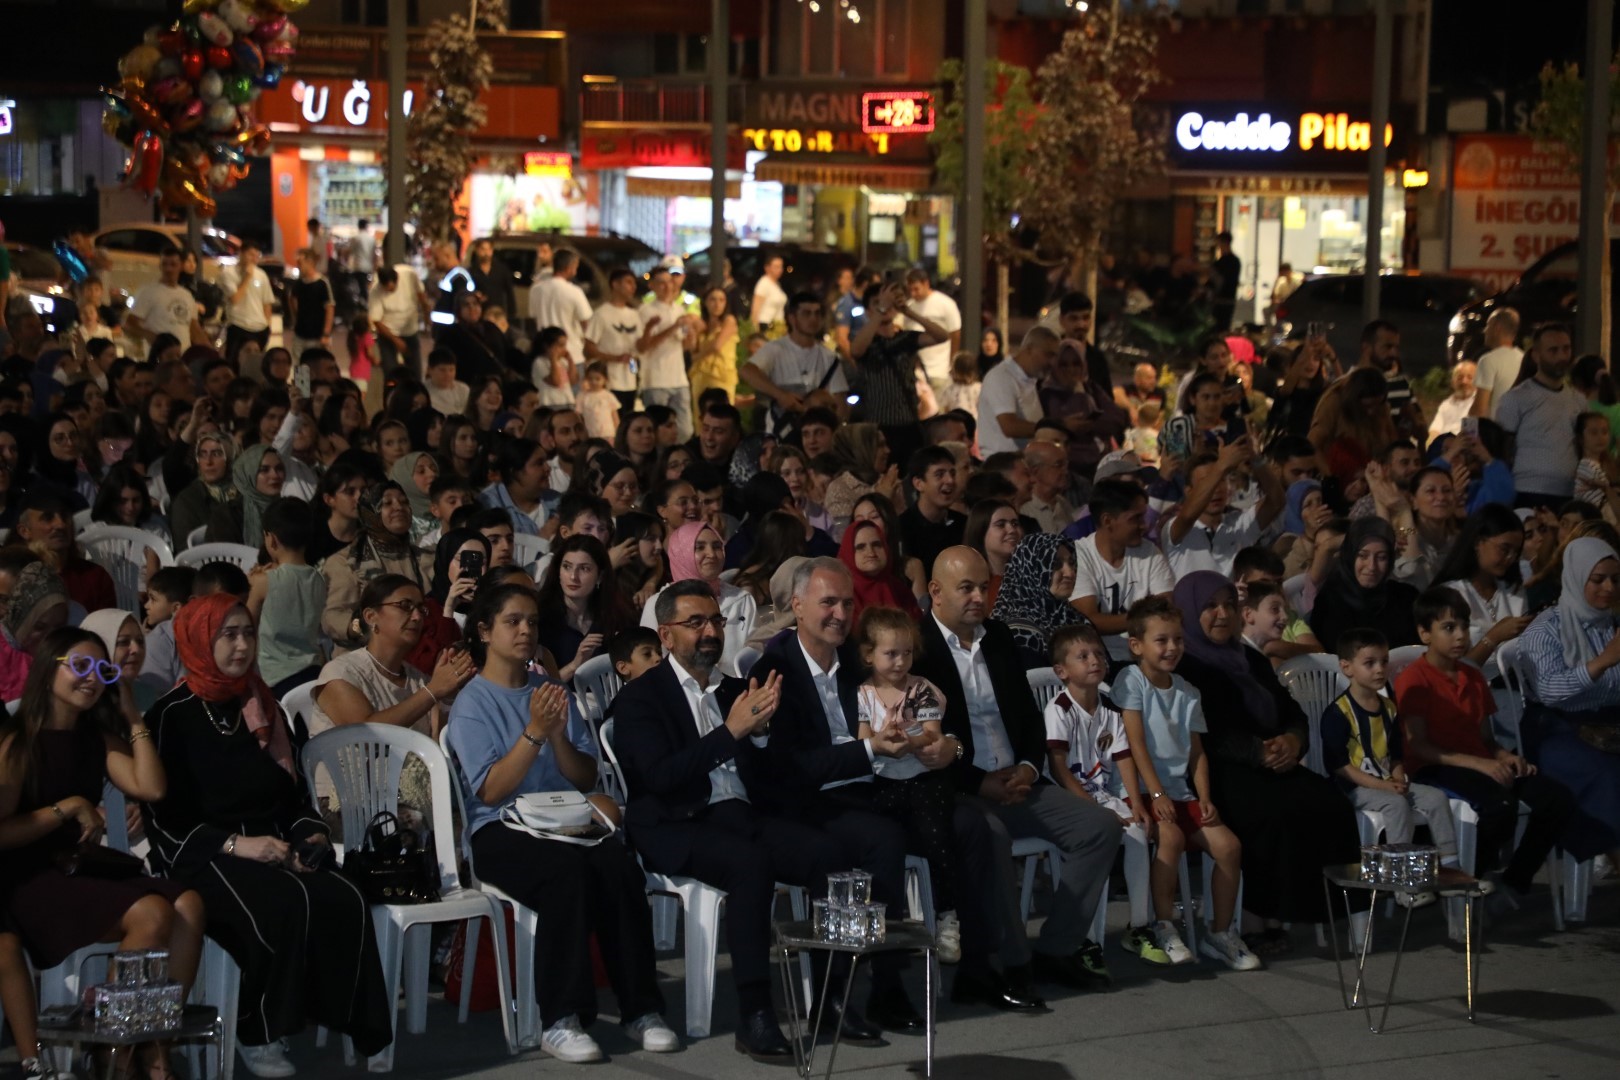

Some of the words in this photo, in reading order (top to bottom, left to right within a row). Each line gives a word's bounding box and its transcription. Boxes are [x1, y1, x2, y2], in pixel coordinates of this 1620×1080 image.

[1176, 111, 1291, 151] Cadde
[1539, 172, 1581, 185] MAĞA
[1479, 234, 1504, 258] 2.
